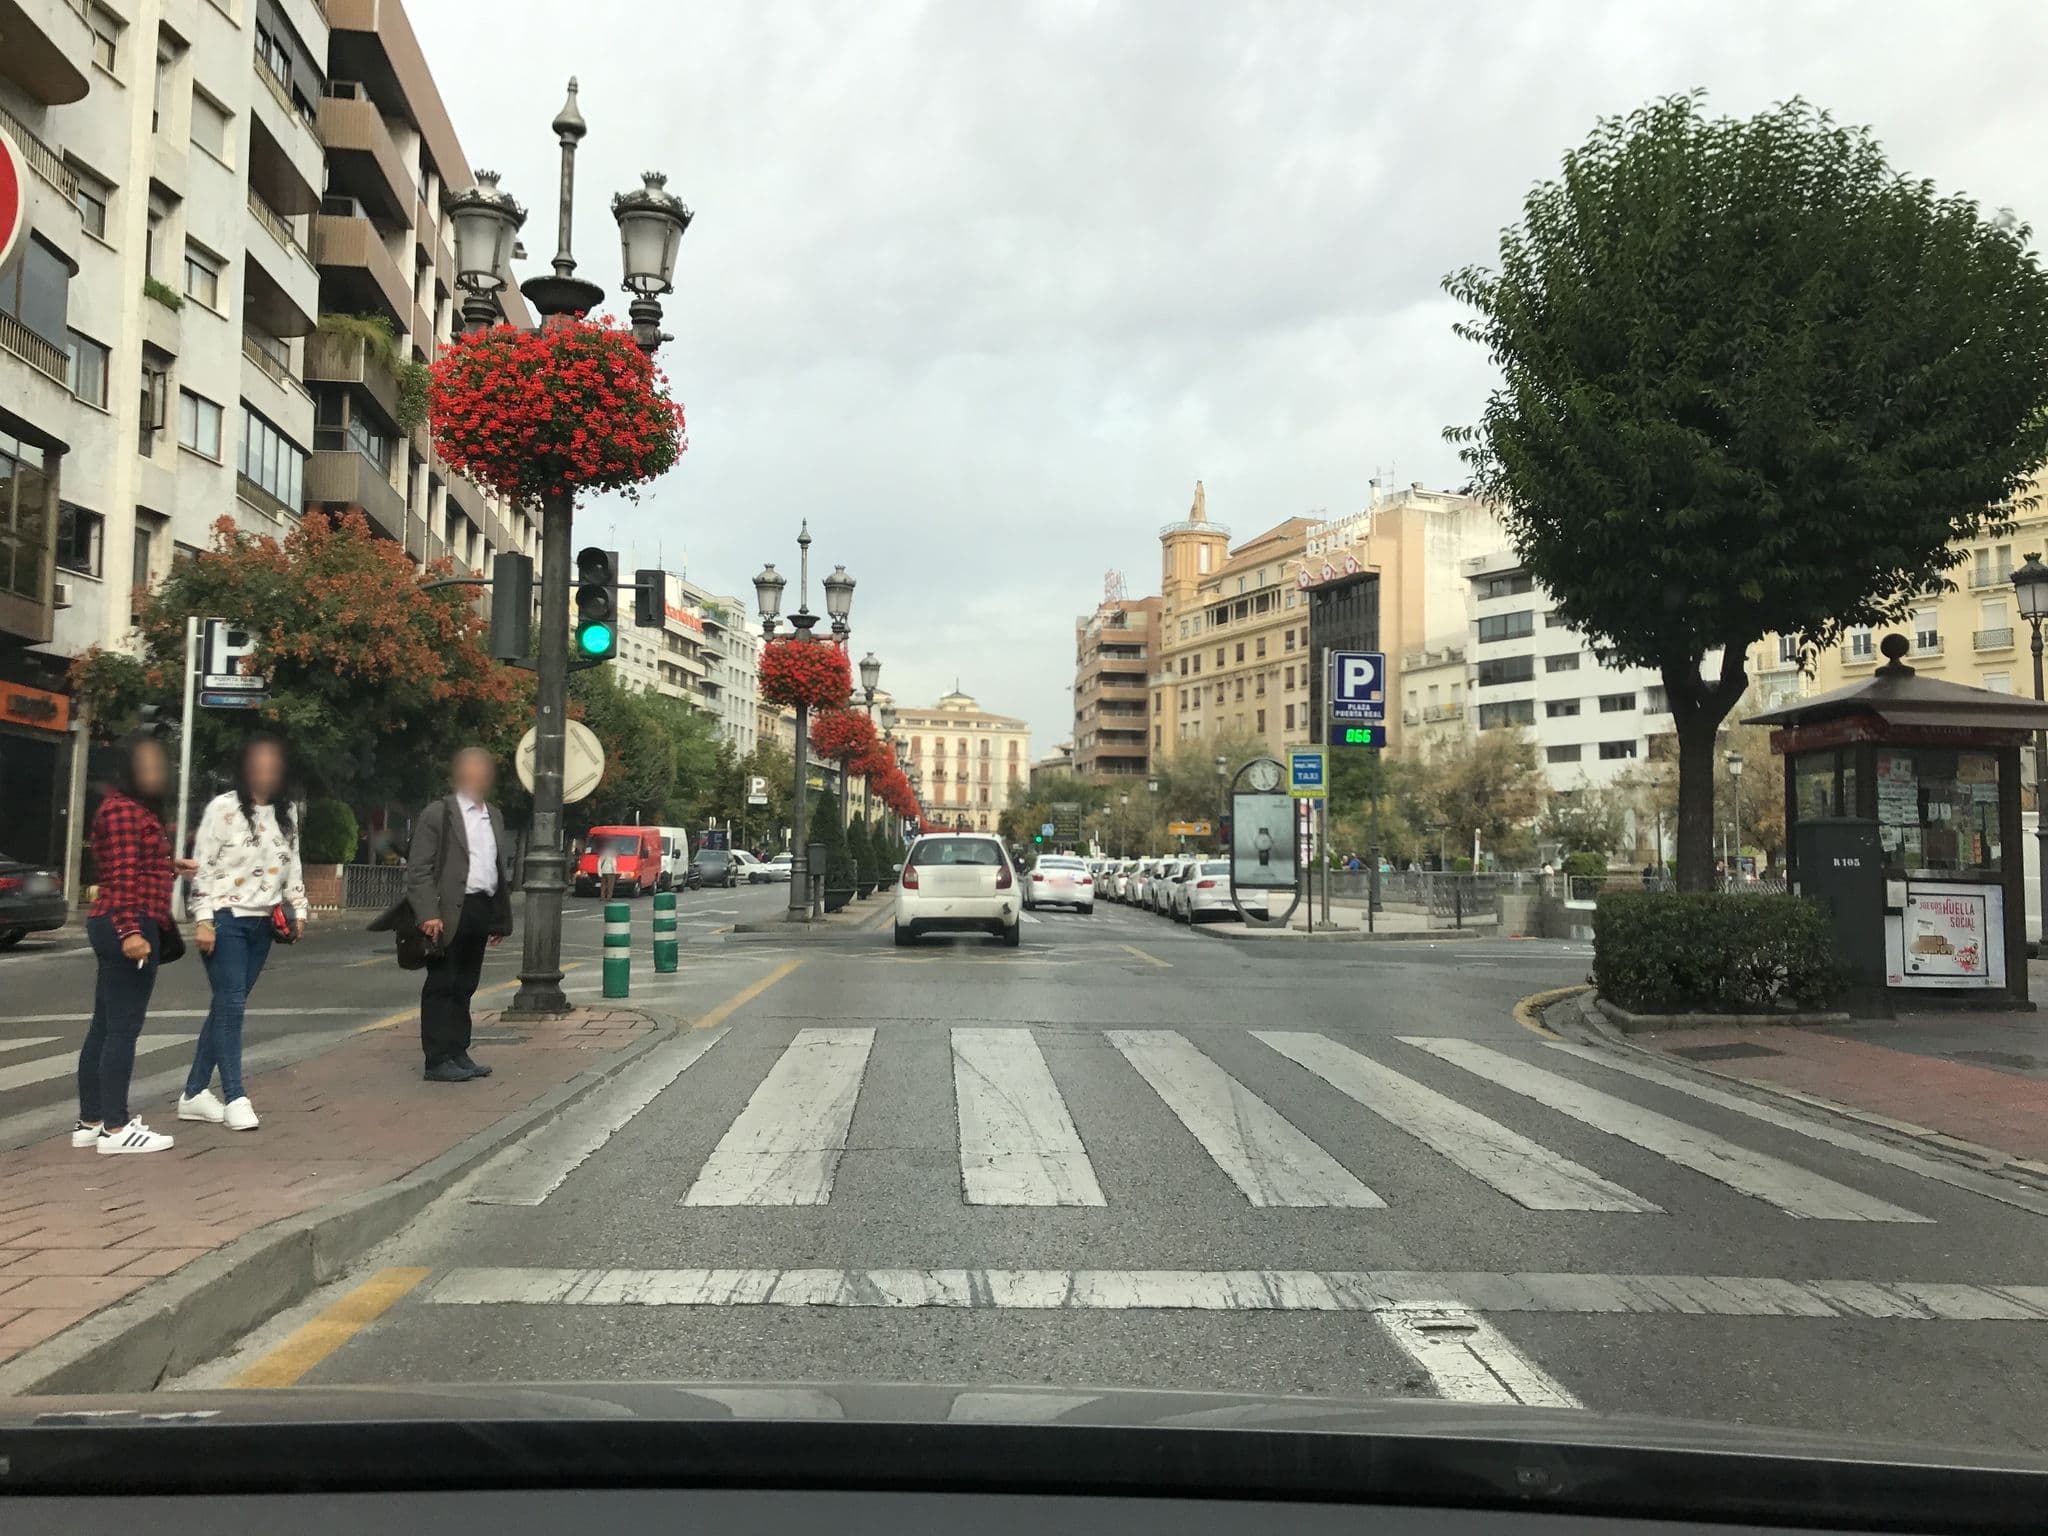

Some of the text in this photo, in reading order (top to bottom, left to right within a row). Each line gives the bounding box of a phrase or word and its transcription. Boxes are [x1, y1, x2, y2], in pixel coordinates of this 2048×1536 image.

[211, 621, 260, 674] P
[1343, 658, 1375, 698] P
[1335, 710, 1362, 718] PUERTA
[1347, 703, 1371, 711] PLAZA
[1345, 728, 1372, 743] 066
[1296, 772, 1319, 780] TAXI
[751, 777, 766, 793] P
[1833, 858, 1840, 867] R
[1943, 899, 1975, 915] HUELLA
[1950, 917, 1976, 931] SOCIAL
